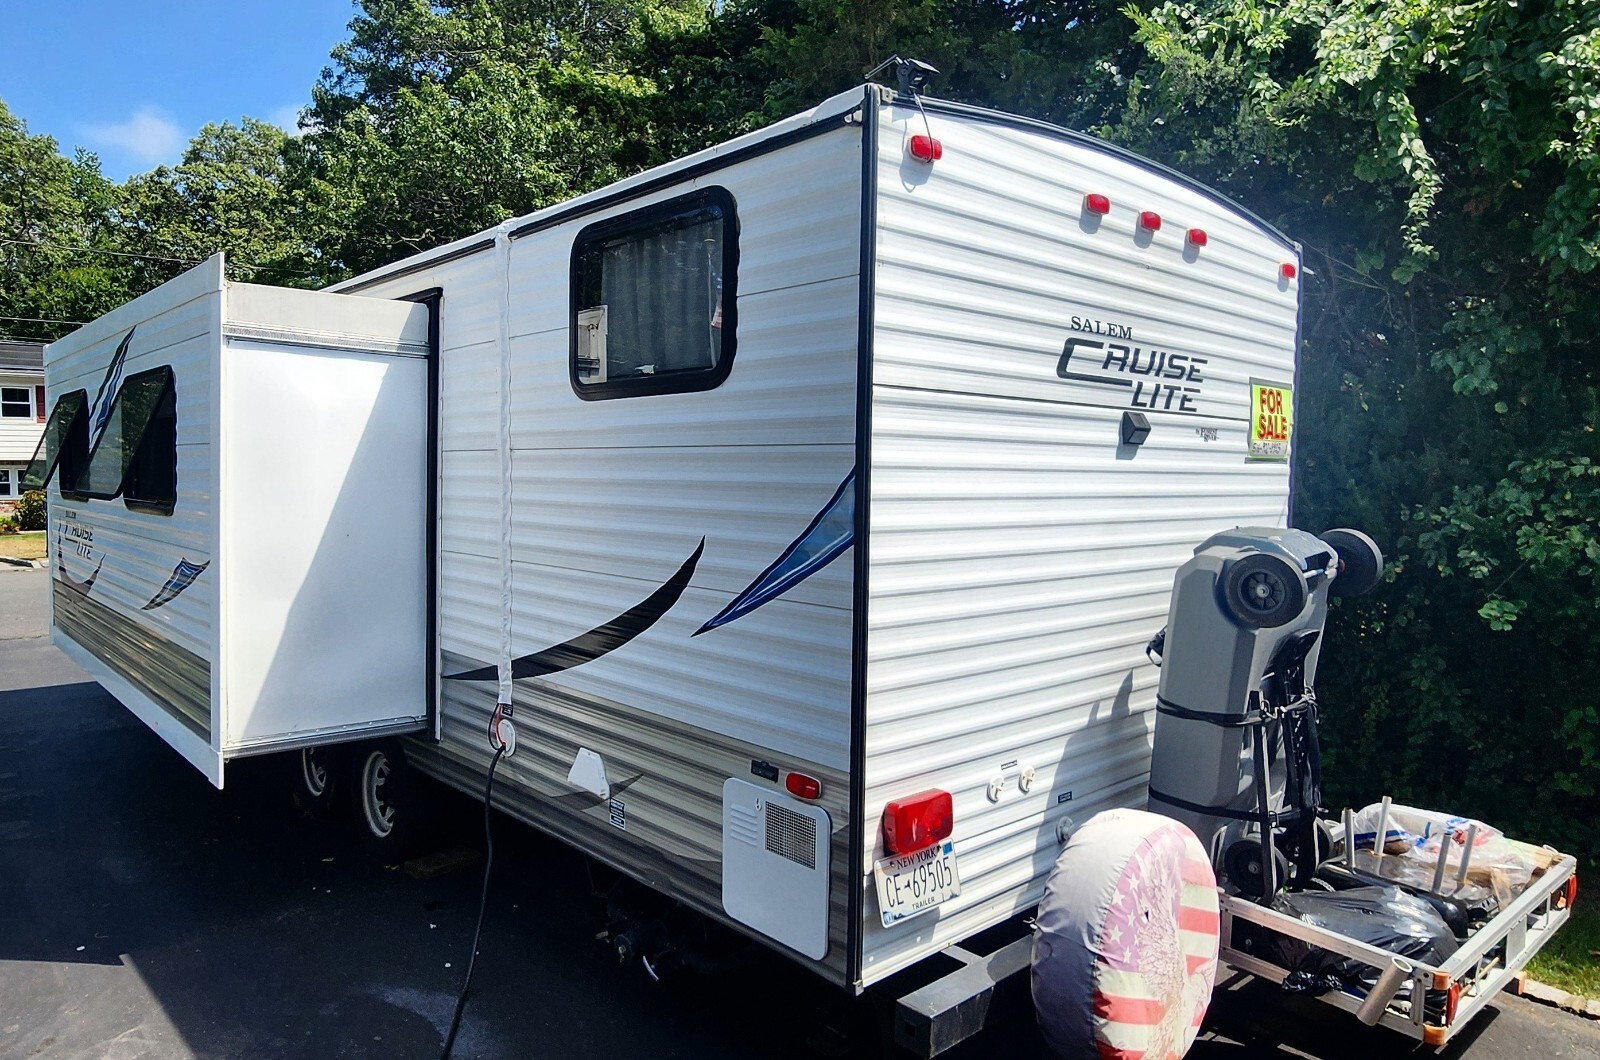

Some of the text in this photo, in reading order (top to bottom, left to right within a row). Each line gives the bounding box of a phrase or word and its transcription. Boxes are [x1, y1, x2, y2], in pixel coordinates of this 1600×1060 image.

[1071, 316, 1133, 340] SALEM
[1056, 337, 1208, 387] CRUISE
[1131, 381, 1201, 412] LITE
[1260, 387, 1283, 415] FOR
[1257, 413, 1288, 440] SALE
[896, 848, 937, 870] NEW YORK
[912, 896, 936, 910] TRAILER
